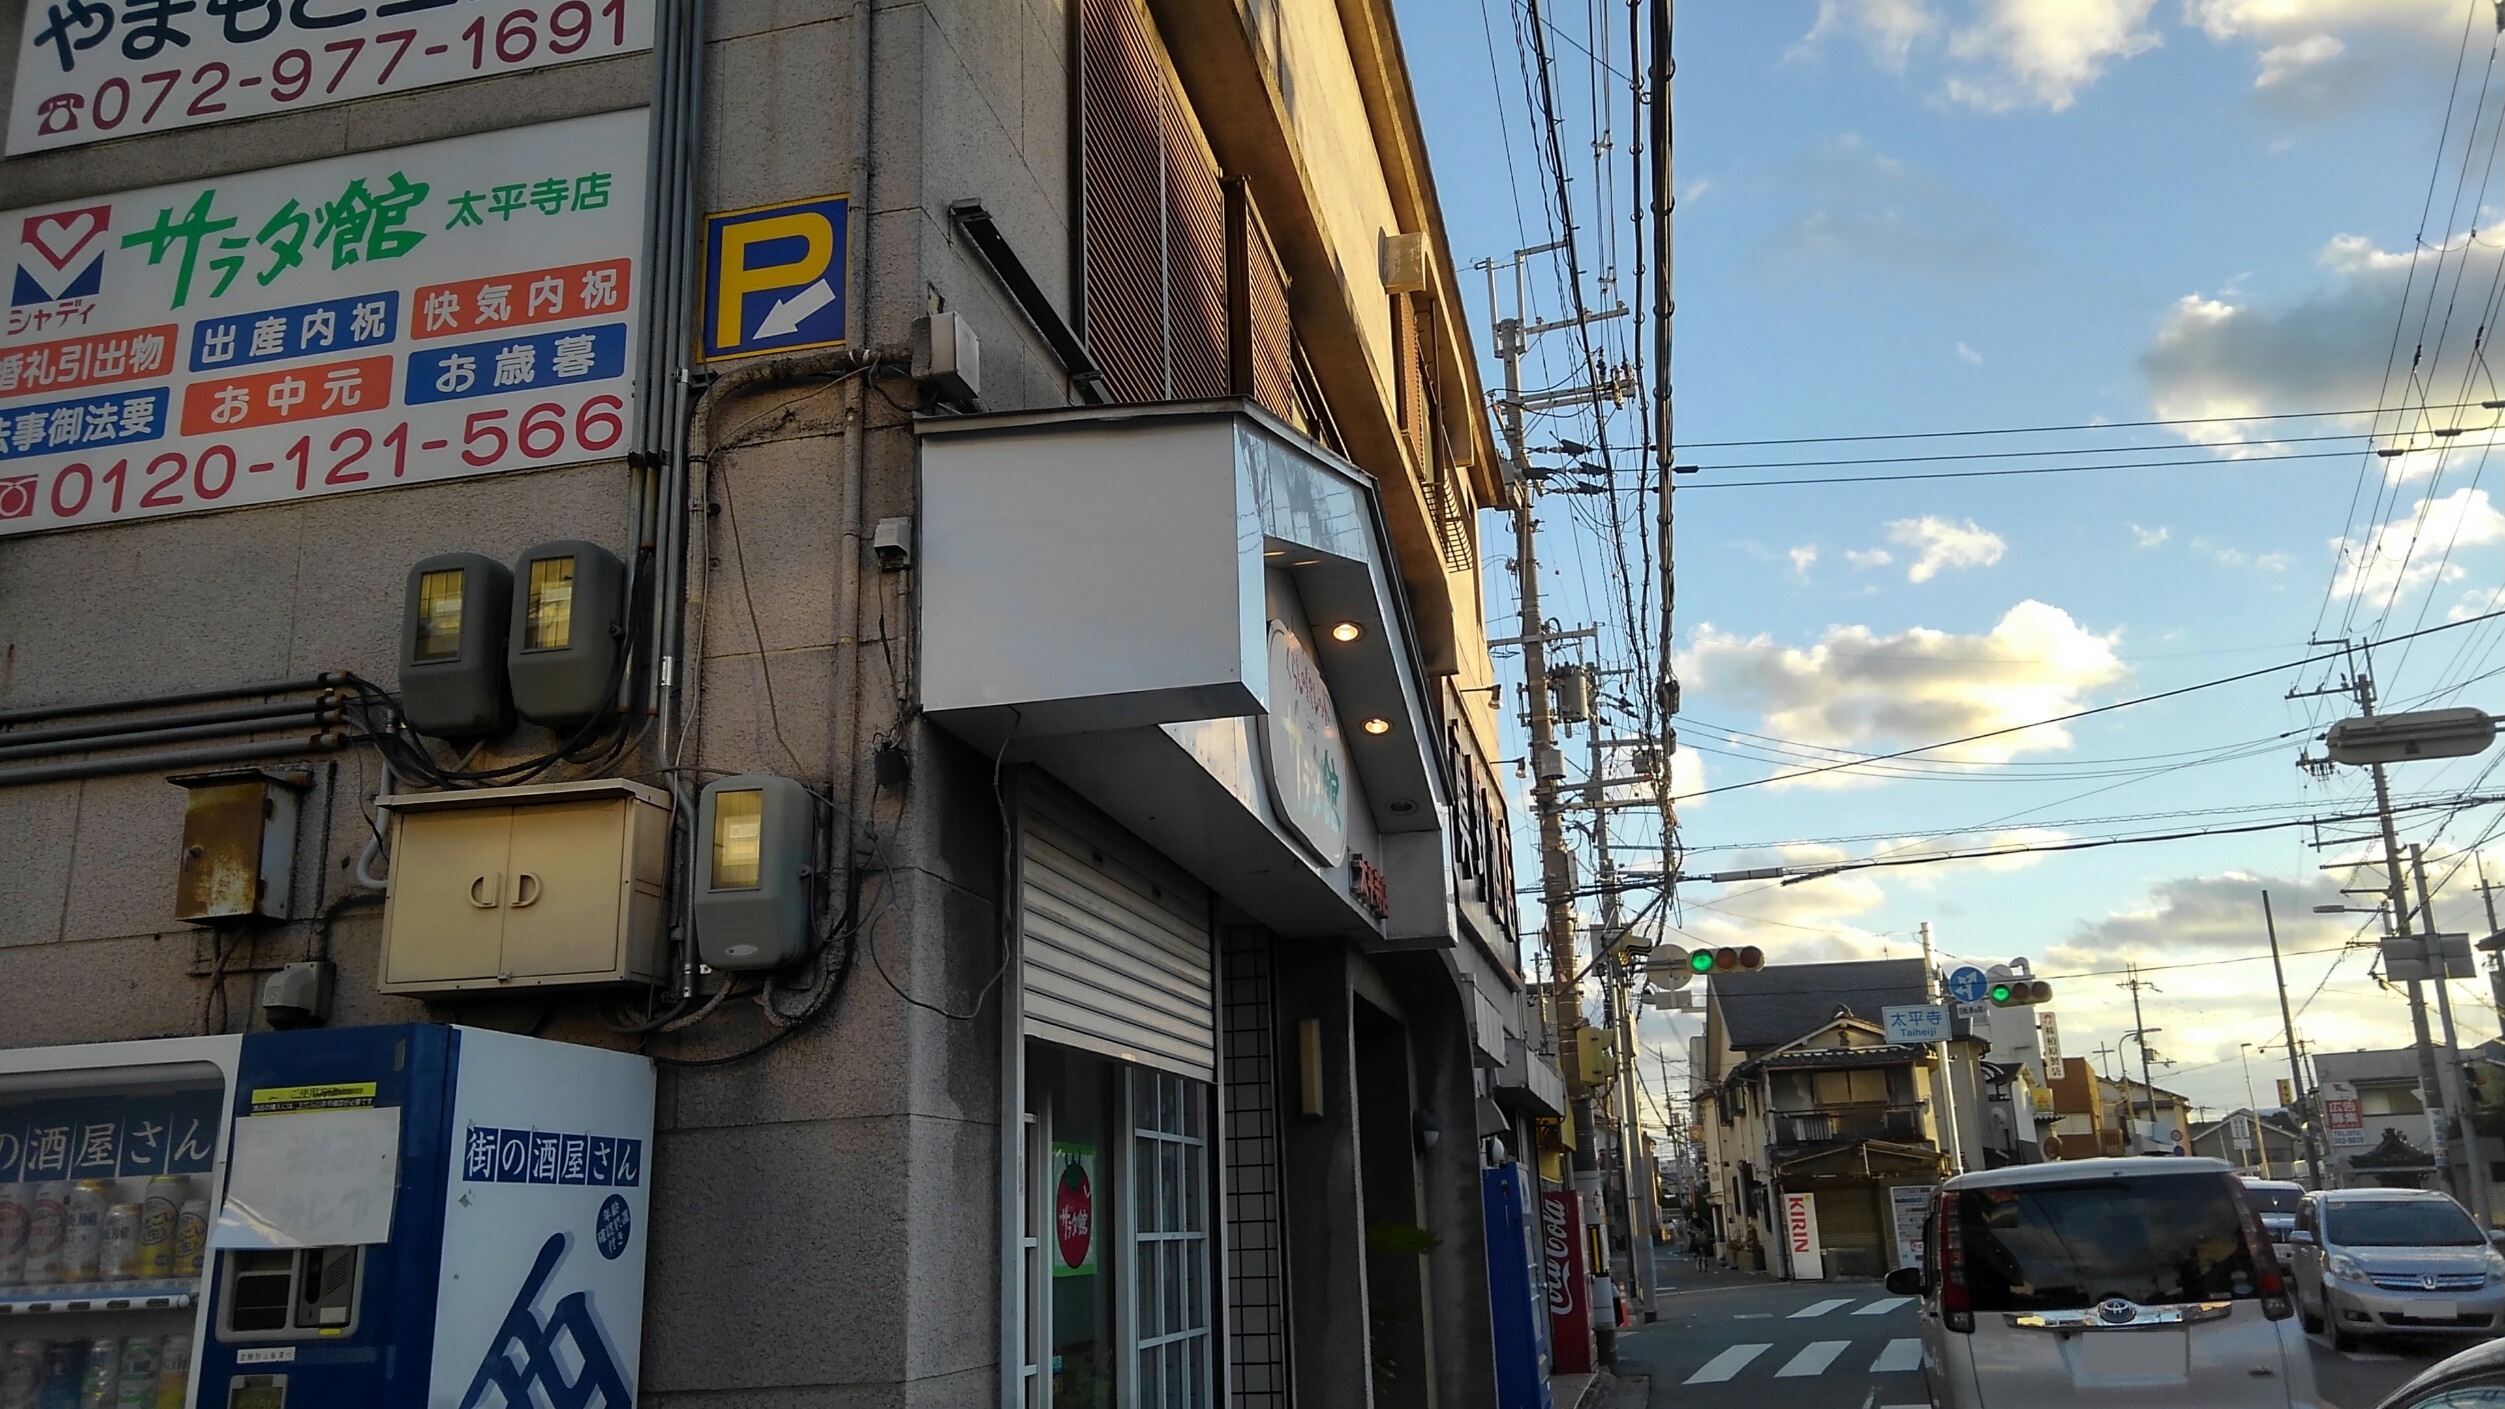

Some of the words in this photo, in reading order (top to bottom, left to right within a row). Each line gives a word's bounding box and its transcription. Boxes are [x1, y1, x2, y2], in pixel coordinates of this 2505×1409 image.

[34, 0, 474, 71] やまも
[92, 0, 628, 130] 072-977-1691
[445, 172, 612, 230] 太平寺店
[424, 266, 617, 328] 快気内祝
[717, 212, 833, 348] P
[7, 300, 96, 335] シャディ
[201, 303, 386, 364] 出産内祝
[435, 335, 595, 393] お歳暮
[211, 367, 362, 424] お中元
[51, 394, 623, 517] 0120-121-566
[1891, 1010, 1942, 1027] 太平寺
[1901, 1028, 1937, 1038] Taiheiji
[466, 1131, 637, 1182] 街の酒屋さん
[1788, 1196, 1809, 1253] KIRIN
